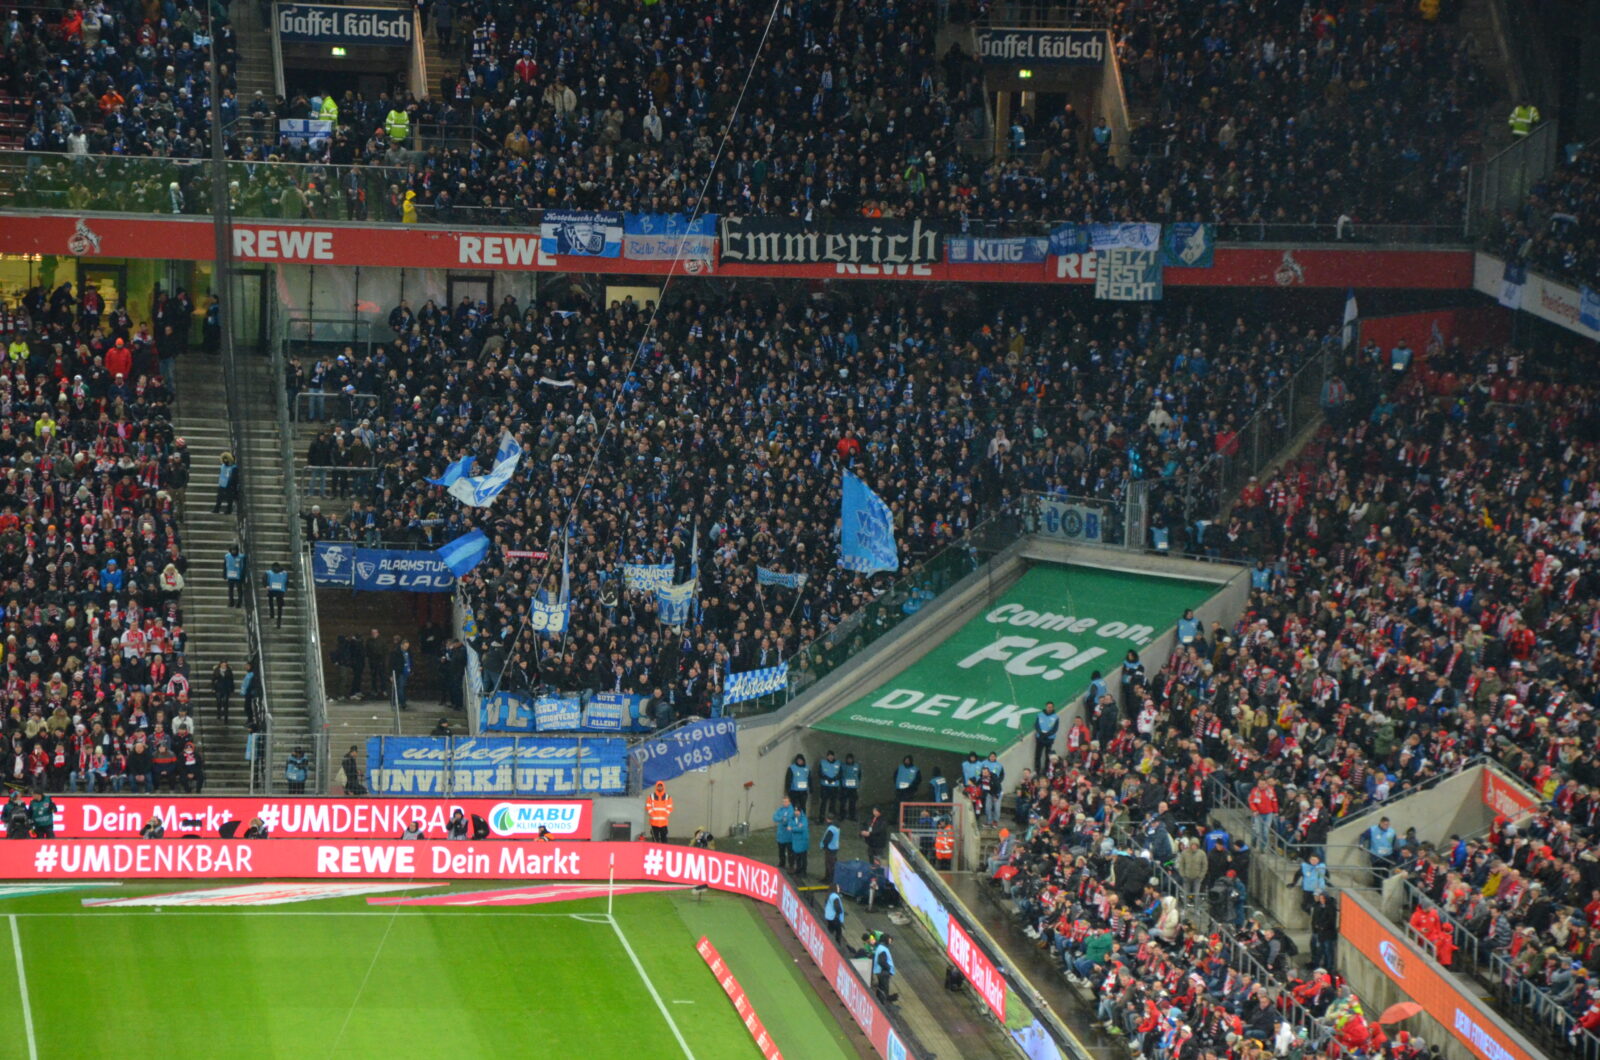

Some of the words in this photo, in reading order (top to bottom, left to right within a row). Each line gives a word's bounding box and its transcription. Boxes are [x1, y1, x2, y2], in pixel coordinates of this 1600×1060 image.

[279, 8, 341, 36] Gaffel
[343, 13, 411, 41] Kölsch
[979, 33, 1035, 59] Gaffel
[1038, 35, 1104, 62] Kölsch
[233, 229, 334, 260] REWE
[459, 236, 557, 267] REWE
[720, 216, 938, 264] Emmerich
[1057, 253, 1097, 279] RE
[1097, 248, 1156, 266] JETZT
[1098, 263, 1147, 284] ERST
[1094, 282, 1156, 301] RECHT
[378, 559, 450, 573] ALARMSTUF
[375, 574, 455, 588] BLAU
[532, 611, 565, 632] 99
[985, 603, 1098, 633] Come
[1096, 621, 1154, 645] on,
[957, 635, 1108, 680] FC!
[871, 688, 1042, 729] DEVK
[402, 741, 593, 765] unbequem
[634, 743, 668, 762] Die
[674, 721, 736, 747] Treuen
[674, 746, 713, 771] 1983
[370, 765, 625, 793] UNVERKÄUFLICH
[82, 804, 142, 832] Dein
[153, 804, 233, 832] Markt
[516, 822, 572, 830] KLIMAFONDS
[517, 808, 575, 821] NABU
[34, 844, 253, 873] #UMDENKBAR
[317, 845, 415, 874] REWE
[432, 846, 491, 874] Dein
[499, 847, 581, 875] Markt
[781, 883, 799, 929] REWE
[949, 922, 971, 974] REWE
[971, 948, 985, 993] Dein
[984, 965, 1003, 1016] Markt
